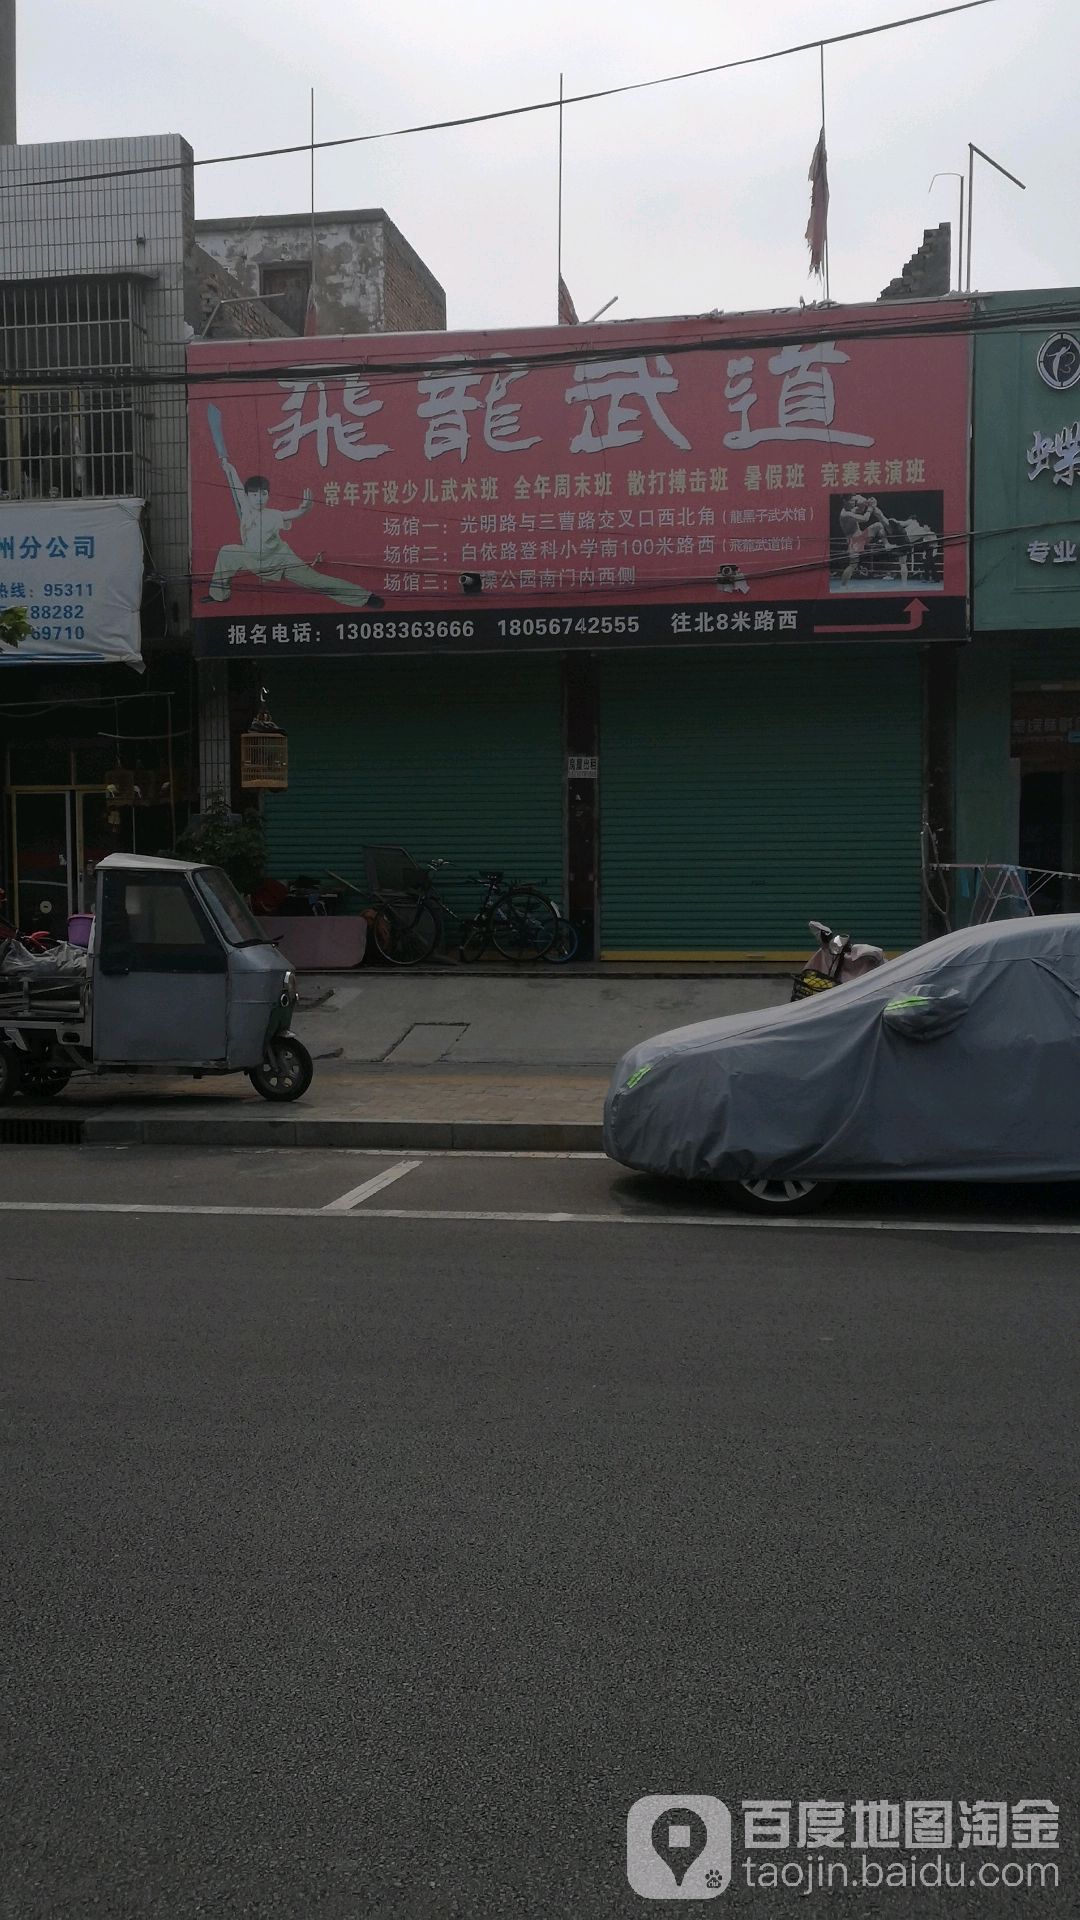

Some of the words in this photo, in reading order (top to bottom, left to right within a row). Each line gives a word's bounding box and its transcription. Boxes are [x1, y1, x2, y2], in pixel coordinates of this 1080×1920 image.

[267, 341, 876, 467] 飛龍武道
[323, 476, 499, 506] 常年开设少儿武术班
[514, 471, 613, 500] 全年周末班
[627, 466, 729, 497] 散打搏击班
[743, 463, 806, 490] 暑假班
[821, 458, 926, 488] 竞赛表演班
[0, 536, 95, 559] 州分公司
[1027, 540, 1077, 564] 专业
[383, 565, 636, 593] 场馆三：操公园南门内西侧
[497, 615, 640, 637] 18056742555
[671, 609, 799, 633] 往北8米路西
